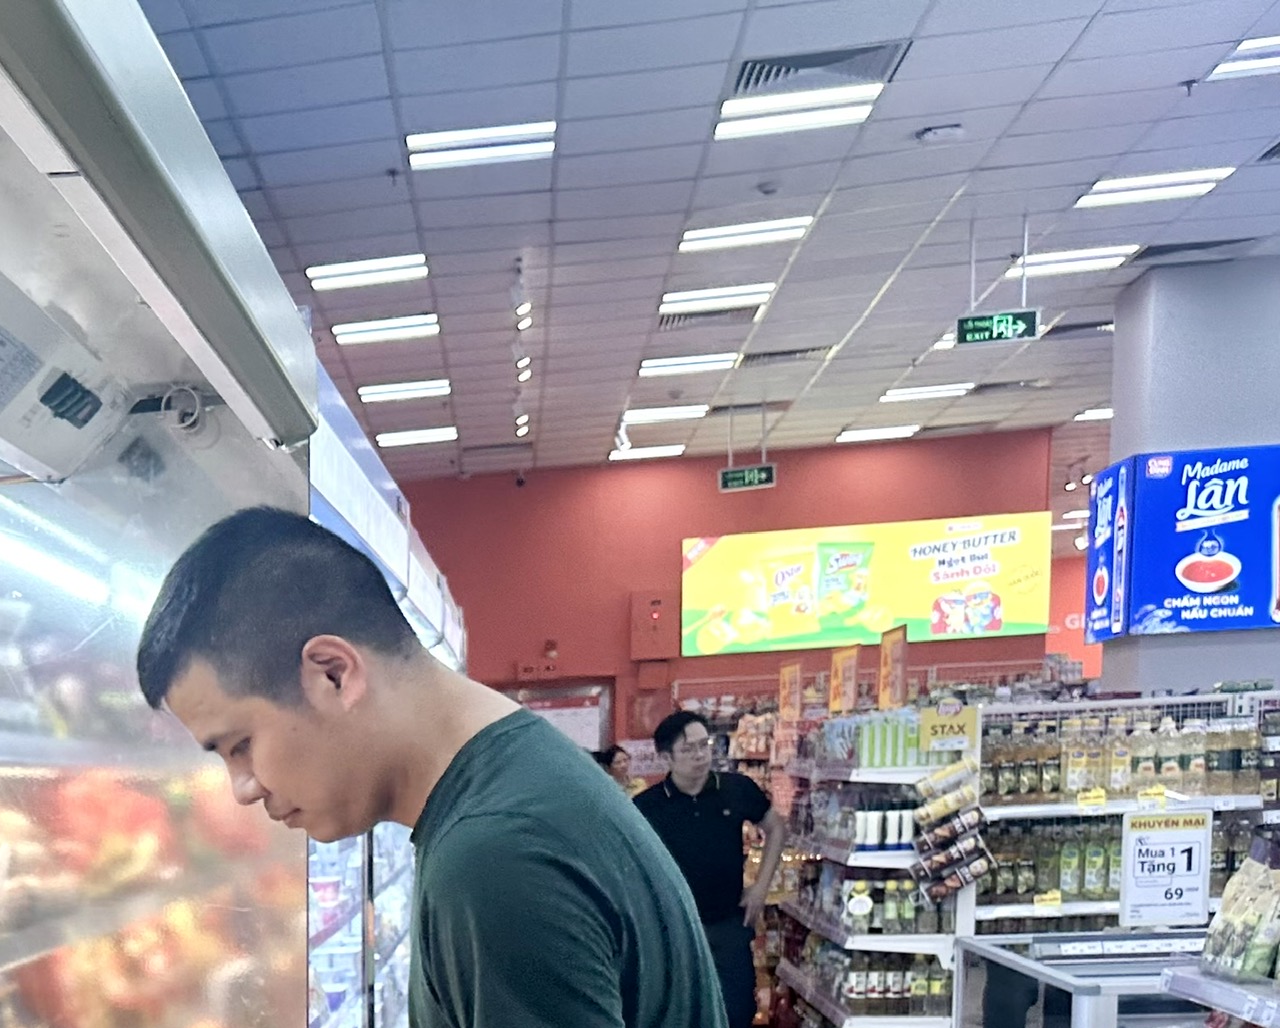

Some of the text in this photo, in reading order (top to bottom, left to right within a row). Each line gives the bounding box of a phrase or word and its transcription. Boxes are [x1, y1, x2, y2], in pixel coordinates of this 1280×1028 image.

[1181, 457, 1250, 485] Madame
[910, 530, 1018, 557] HONEY BUTTER
[1202, 594, 1240, 606] NGON
[930, 722, 966, 737] STAX
[1130, 818, 1179, 829] KHUYẾN
[1138, 847, 1175, 859] Mua 1
[1180, 846, 1193, 872] 1
[1138, 860, 1176, 874] Tặng
[1164, 887, 1184, 900] 69
